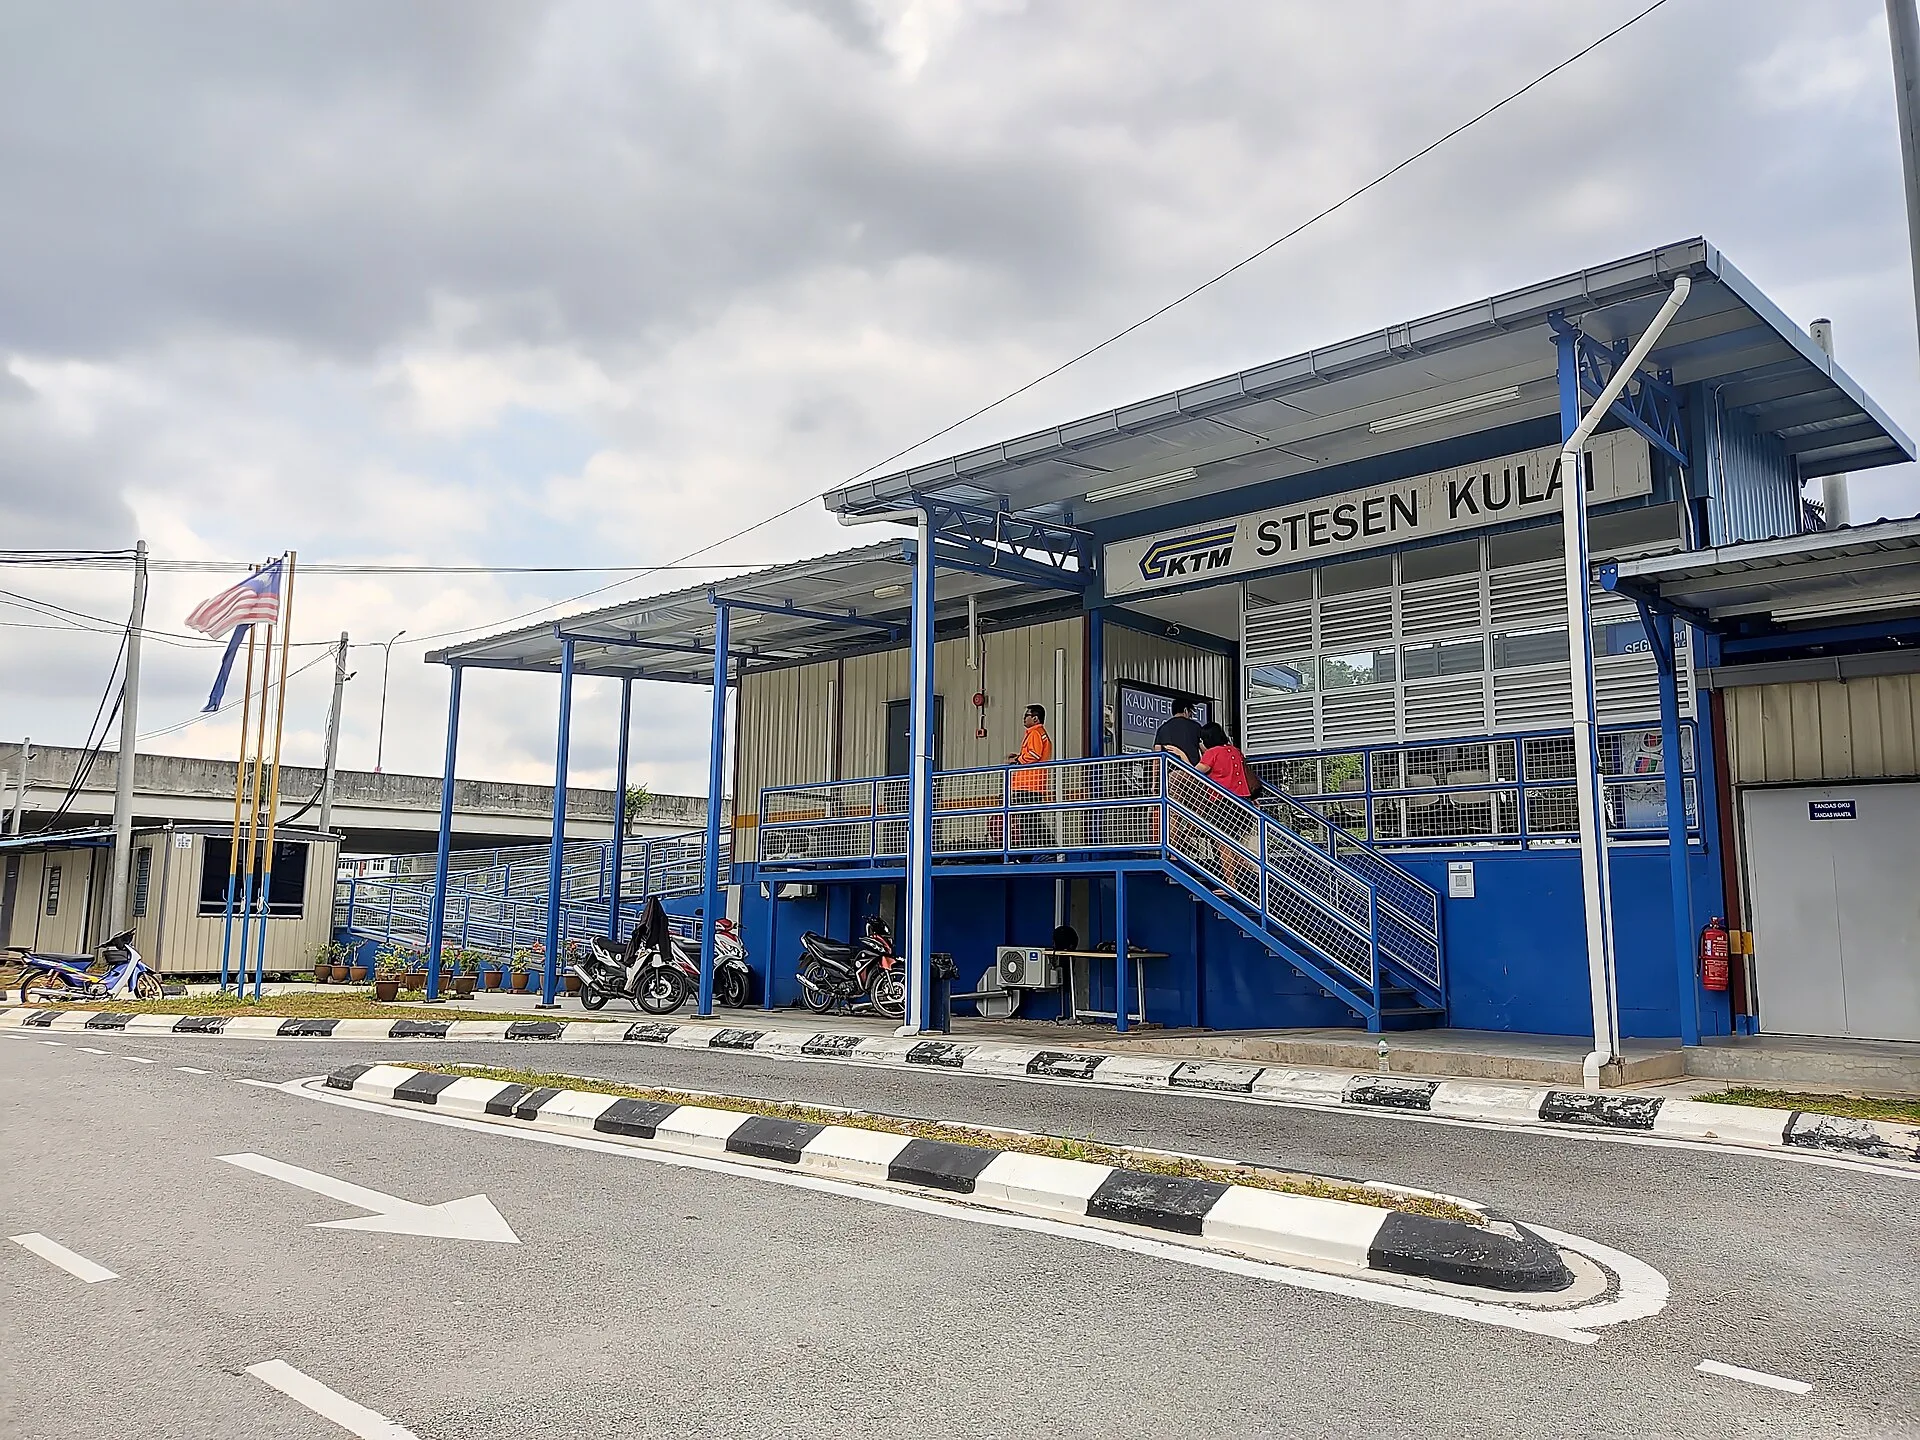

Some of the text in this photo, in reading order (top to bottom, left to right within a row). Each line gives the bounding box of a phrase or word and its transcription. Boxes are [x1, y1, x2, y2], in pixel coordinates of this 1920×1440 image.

[1166, 546, 1233, 578] KTM
[1256, 489, 1419, 557] STESEN
[1125, 692, 1173, 715] KAUNTER
[1127, 713, 1160, 730] TICKET
